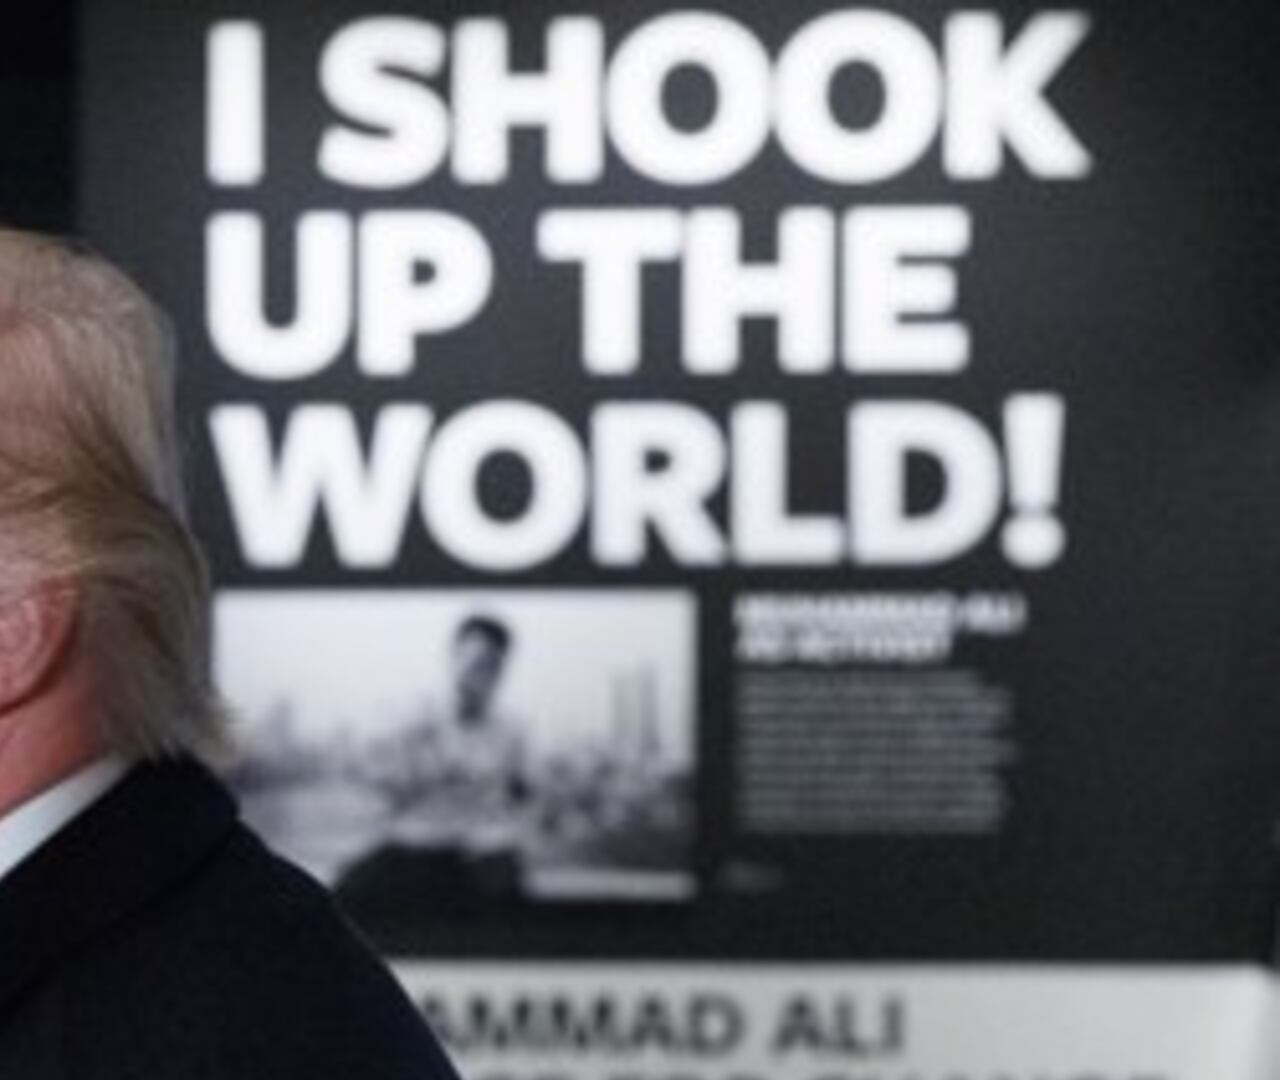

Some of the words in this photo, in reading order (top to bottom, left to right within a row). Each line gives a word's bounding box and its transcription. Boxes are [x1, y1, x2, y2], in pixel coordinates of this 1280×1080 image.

[204, 18, 264, 186] I
[316, 8, 1093, 189] SHOOK
[204, 210, 494, 380] UP
[535, 204, 973, 376] THE
[208, 393, 1067, 571] WORLD!
[769, 991, 906, 1058] ALI
